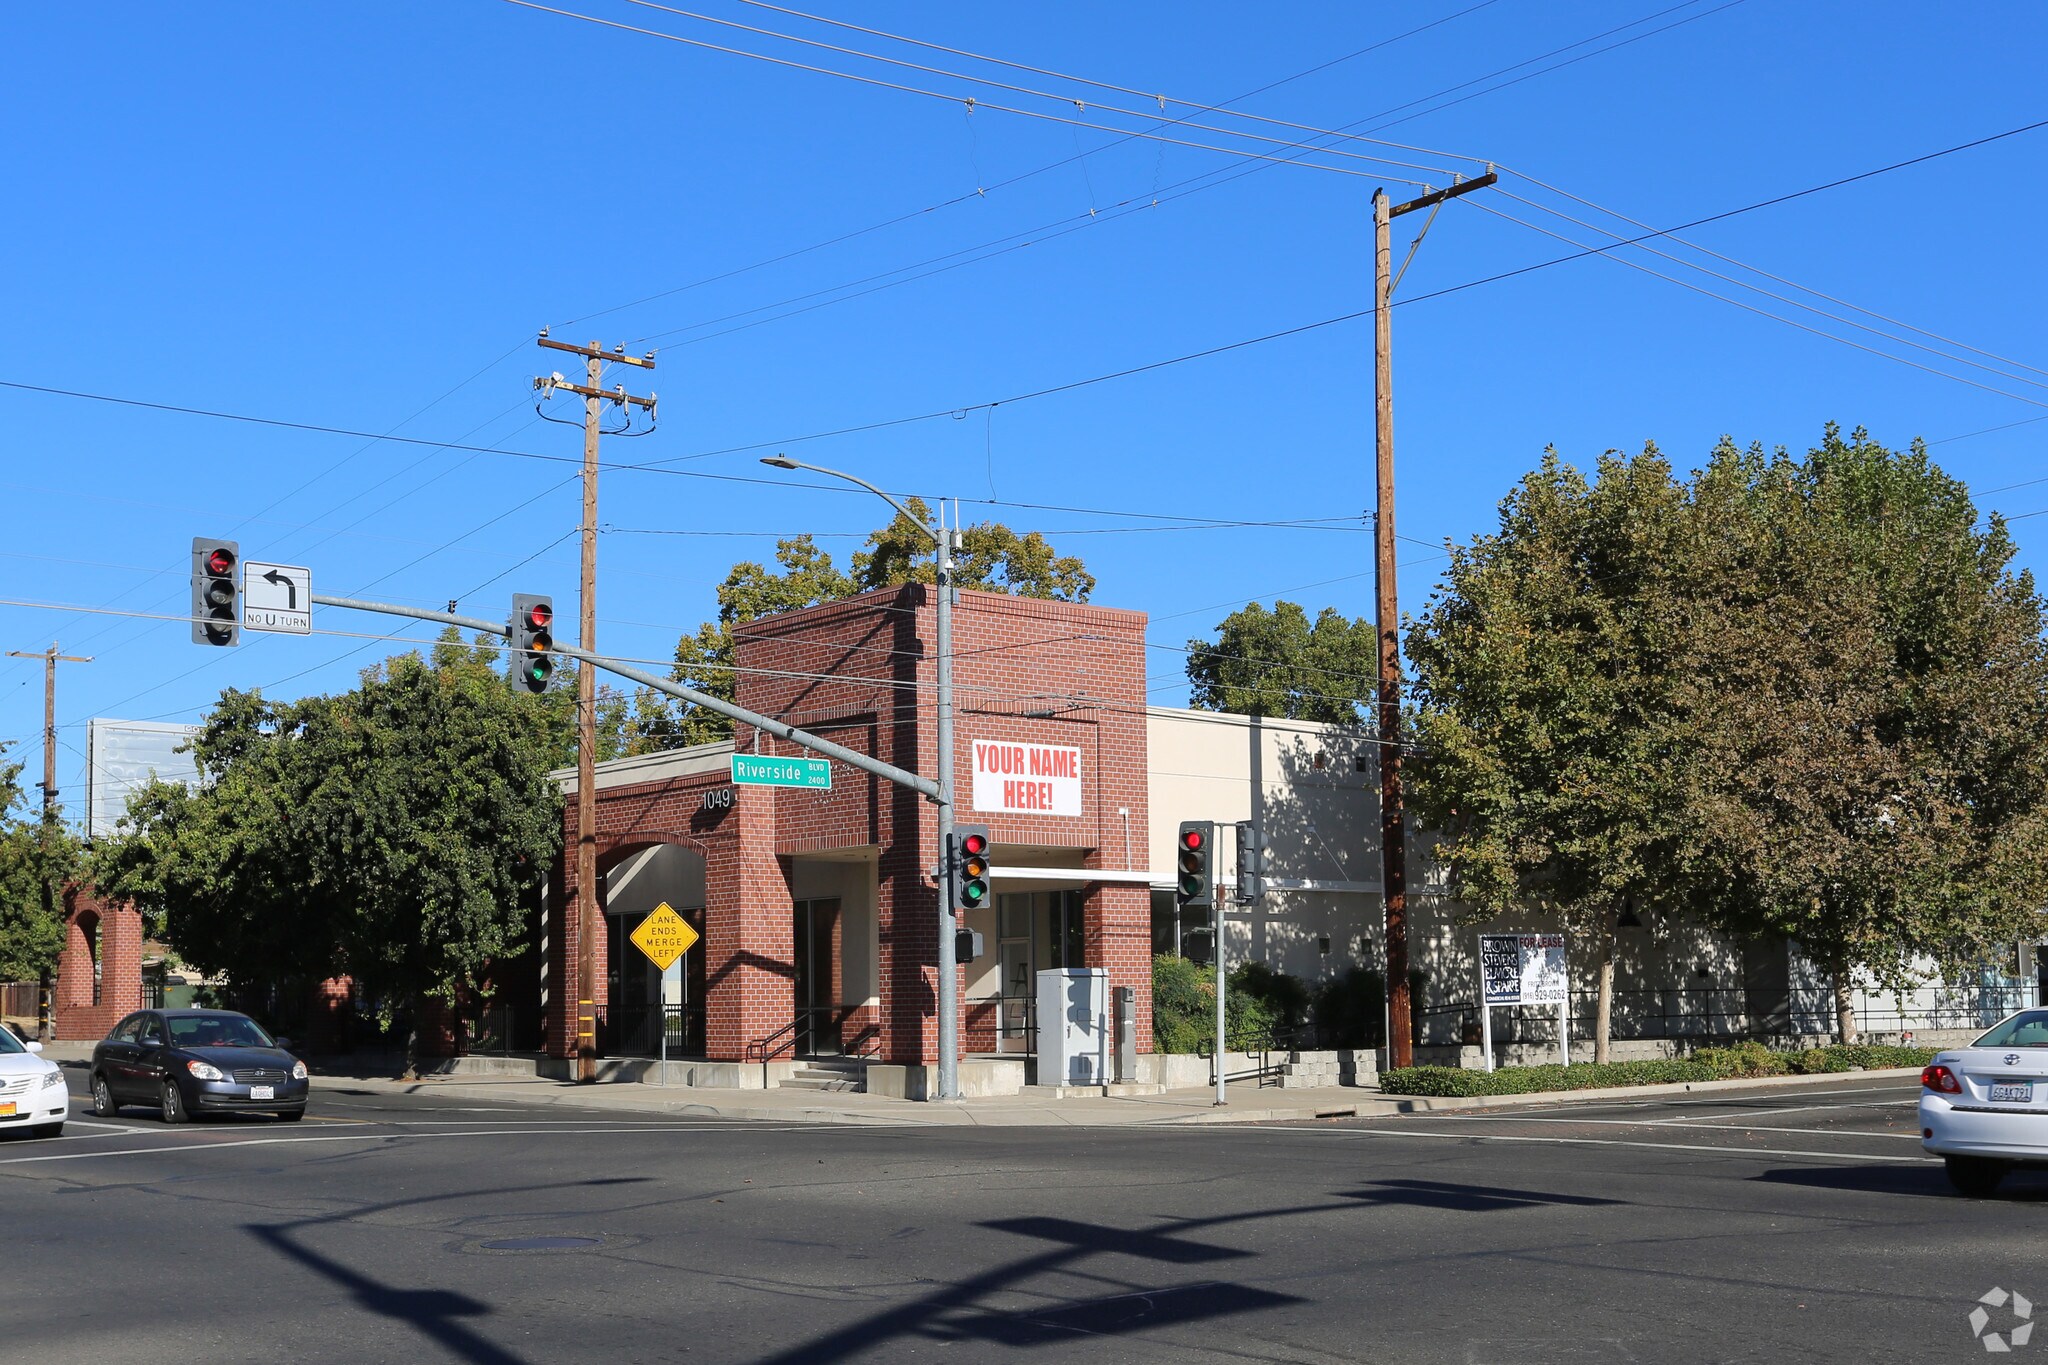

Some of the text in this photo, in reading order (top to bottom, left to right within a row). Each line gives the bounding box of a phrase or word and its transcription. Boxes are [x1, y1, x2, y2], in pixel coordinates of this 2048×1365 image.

[248, 614, 307, 627] NO U TURN
[808, 763, 825, 772] BLVD
[976, 744, 1078, 778] YOUR NAME
[738, 762, 801, 780] Riverside
[808, 776, 826, 785] 2400
[702, 789, 730, 809] 1049
[1004, 780, 1053, 810] HERE!
[651, 915, 677, 924] LANE
[651, 927, 677, 935] ENDS
[646, 938, 682, 946] MERGE
[1483, 940, 1517, 953] BROWN
[1520, 937, 1563, 948] FOR LEASE
[653, 949, 675, 957] LEFT
[1484, 953, 1518, 966] STEVENS
[1485, 966, 1519, 979] ELMORE
[1486, 980, 1496, 995] &
[1534, 989, 1566, 1000] 929-0262
